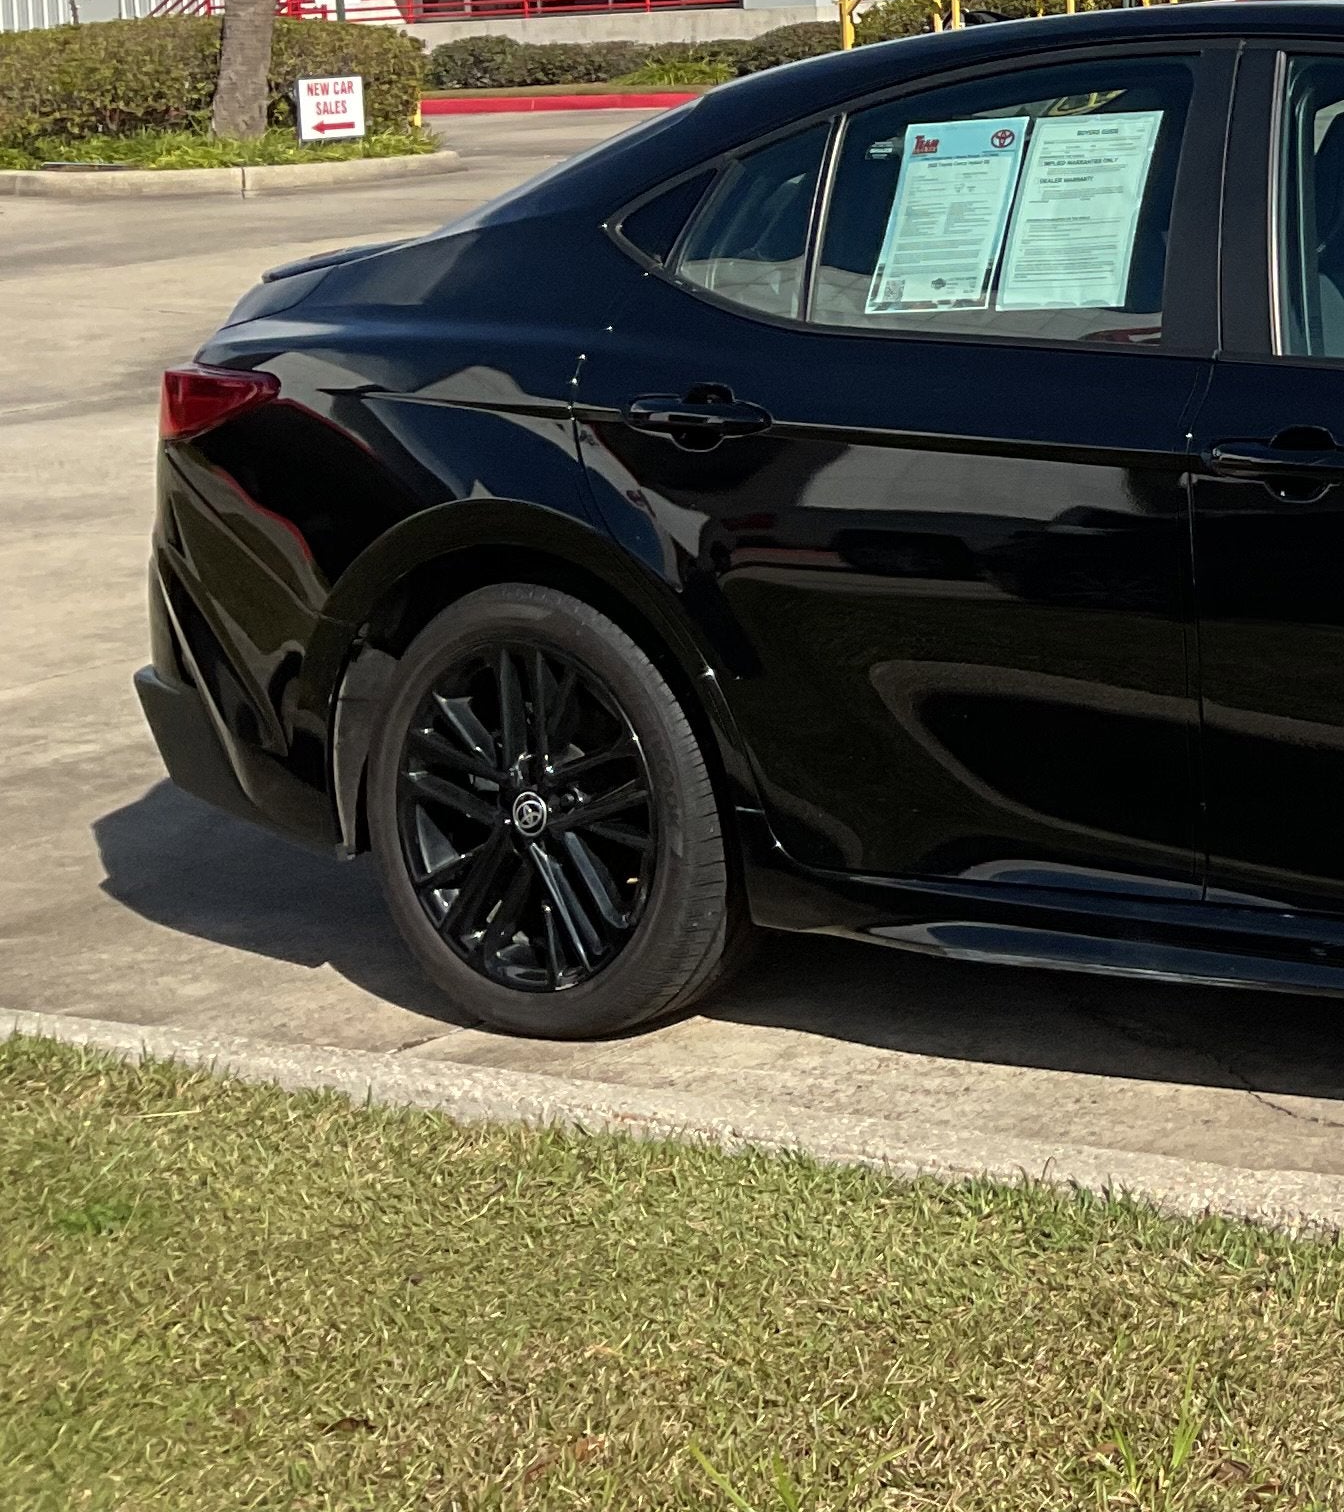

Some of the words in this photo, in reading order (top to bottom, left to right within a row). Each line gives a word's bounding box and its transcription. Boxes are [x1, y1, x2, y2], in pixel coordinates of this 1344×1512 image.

[307, 82, 330, 96] NEW
[333, 81, 354, 95] CAR
[315, 100, 348, 115] SALES
